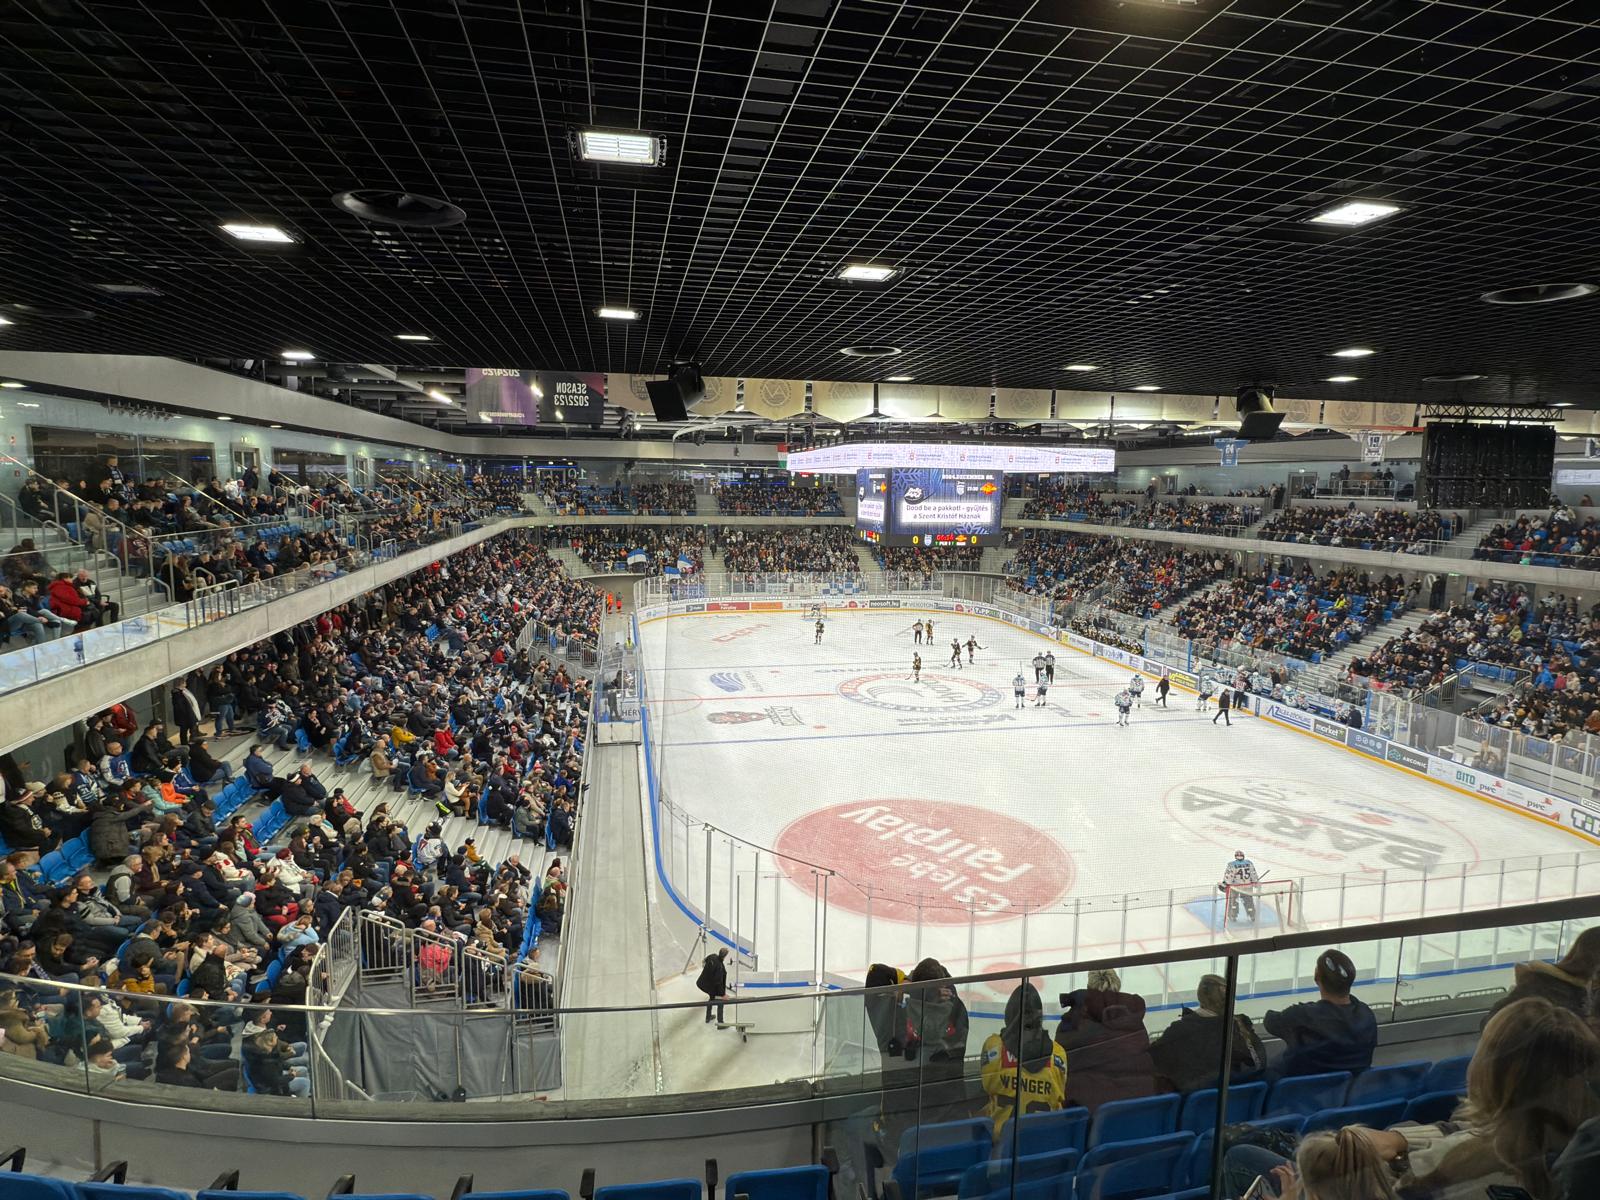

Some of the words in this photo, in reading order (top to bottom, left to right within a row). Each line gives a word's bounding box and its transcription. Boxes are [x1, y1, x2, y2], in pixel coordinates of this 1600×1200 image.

[912, 535, 919, 544] 0
[971, 535, 977, 544] 0
[1479, 783, 1497, 794] pwc
[1181, 790, 1442, 873] BARTA
[839, 805, 1034, 883] Fairplay
[1238, 868, 1251, 880] 45
[1000, 1074, 1052, 1095] WENGER
